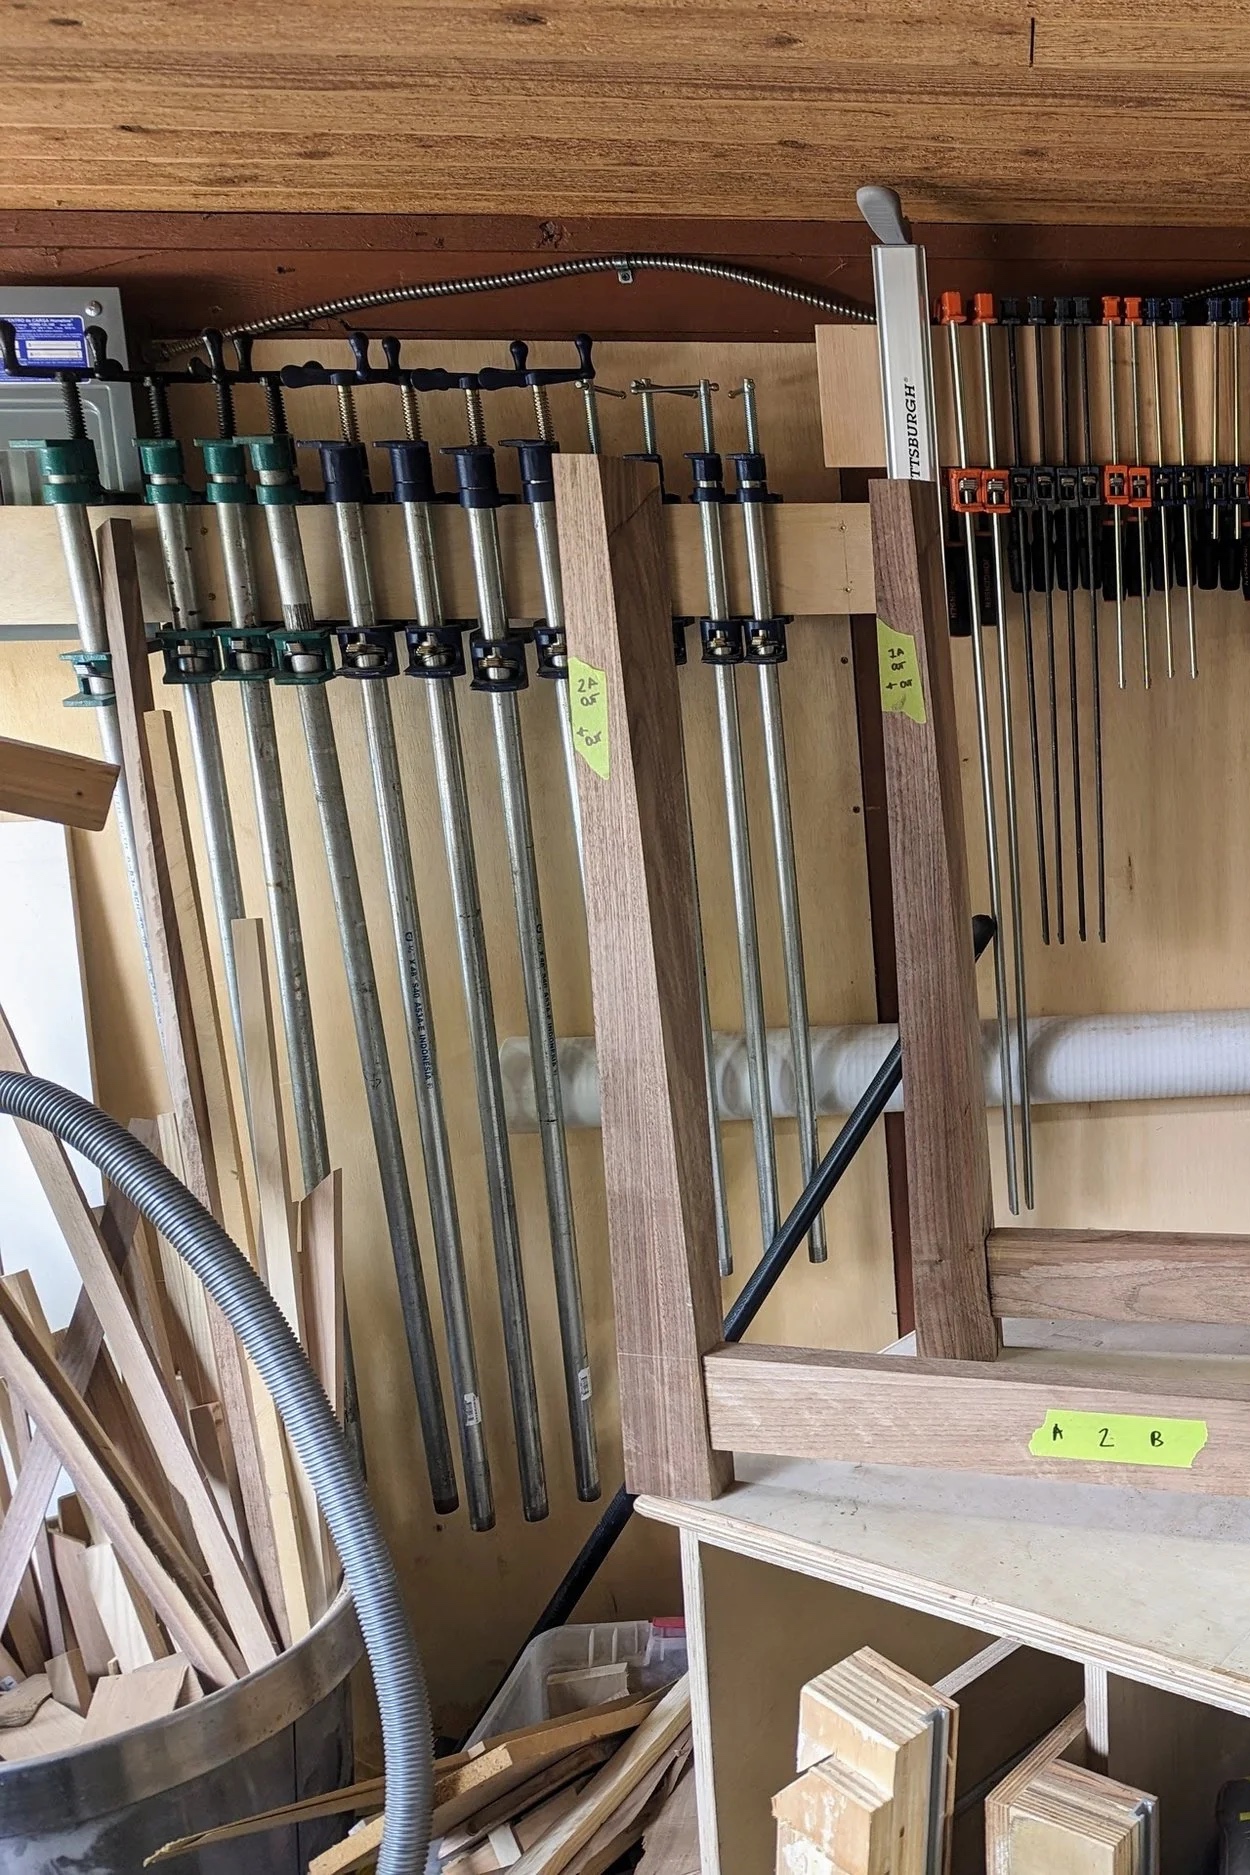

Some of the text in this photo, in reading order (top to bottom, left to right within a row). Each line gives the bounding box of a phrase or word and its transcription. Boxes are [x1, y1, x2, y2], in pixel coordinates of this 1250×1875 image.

[904, 384, 921, 480] TTSBURGH
[577, 677, 598, 693] 2A
[419, 1034, 433, 1081] INDONESIA
[1052, 1423, 1164, 1447] A 2 B
